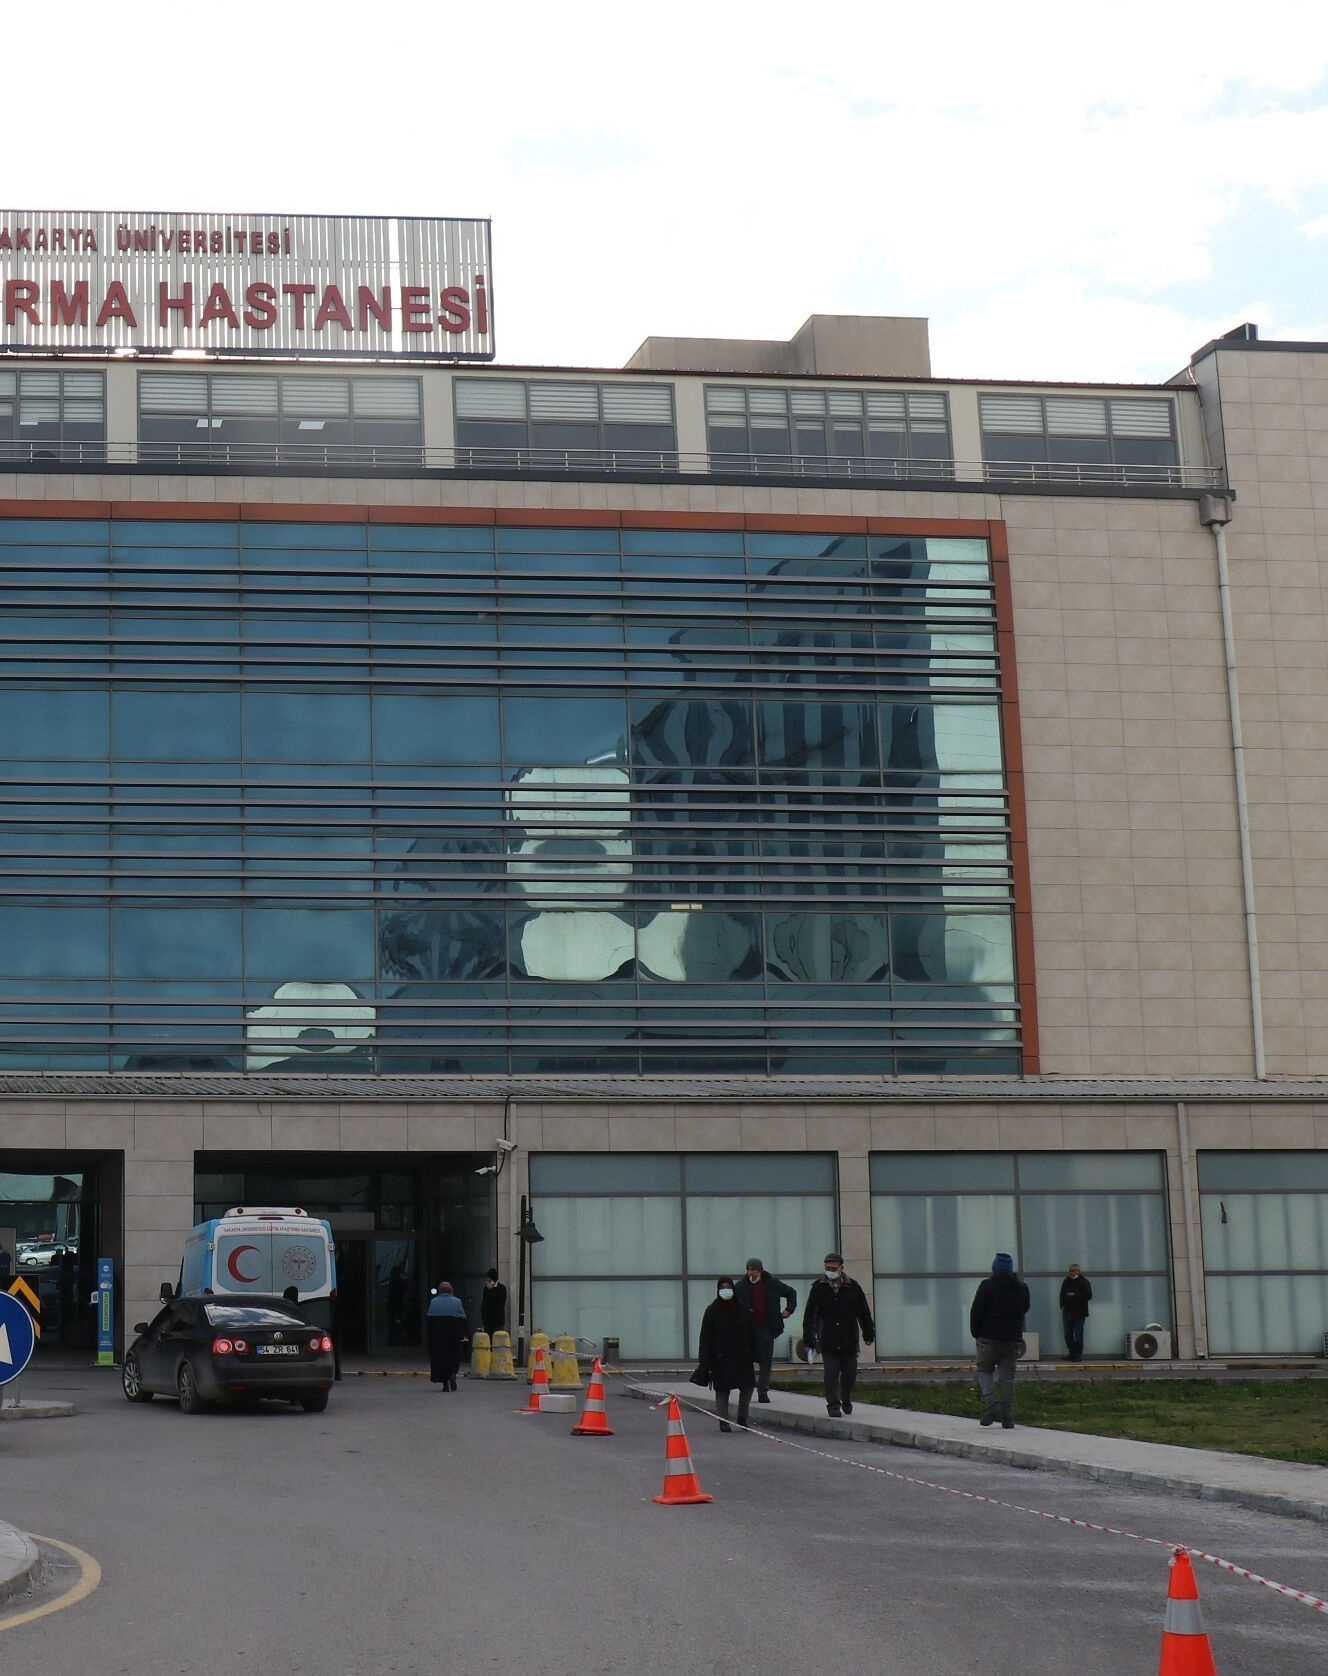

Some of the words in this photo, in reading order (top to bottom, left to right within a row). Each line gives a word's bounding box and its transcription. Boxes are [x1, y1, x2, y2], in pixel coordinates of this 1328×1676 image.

[116, 223, 291, 255] ÜNİVERSİTESİ
[159, 275, 489, 335] HASTANESİ
[273, 1346, 284, 1354] ZR
